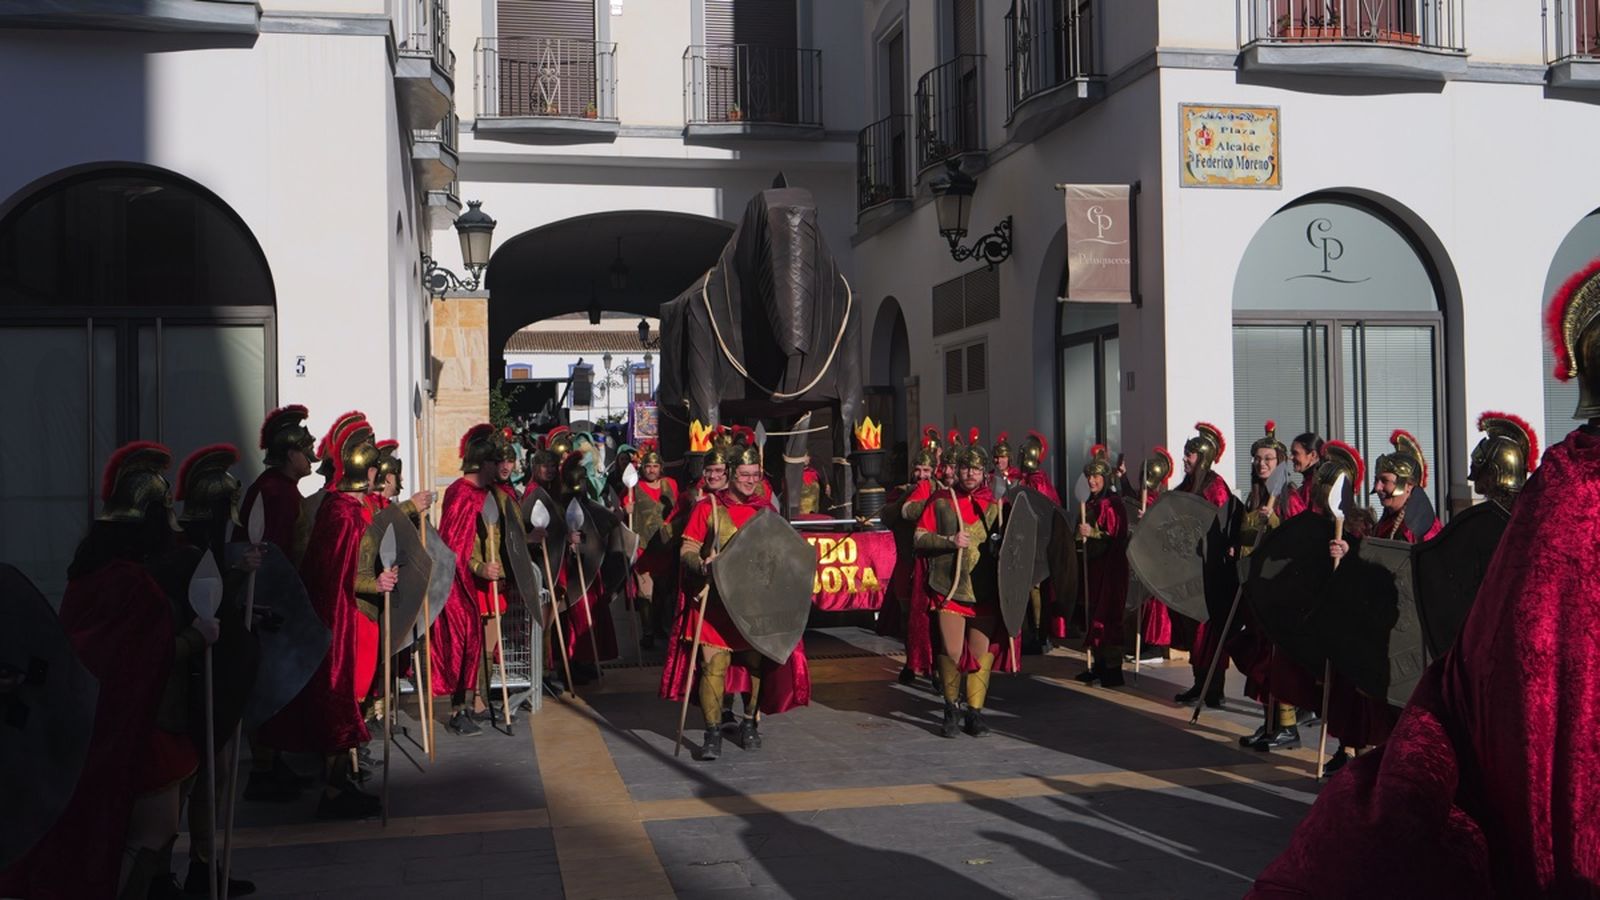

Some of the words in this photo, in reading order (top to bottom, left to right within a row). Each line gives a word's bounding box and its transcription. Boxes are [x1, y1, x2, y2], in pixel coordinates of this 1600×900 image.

[1221, 127, 1256, 135] Plaza
[1216, 142, 1260, 152] Alcalde
[1196, 154, 1233, 169] Federico
[1236, 155, 1269, 170] Moreno
[296, 358, 305, 374] 5
[807, 537, 857, 565] DO
